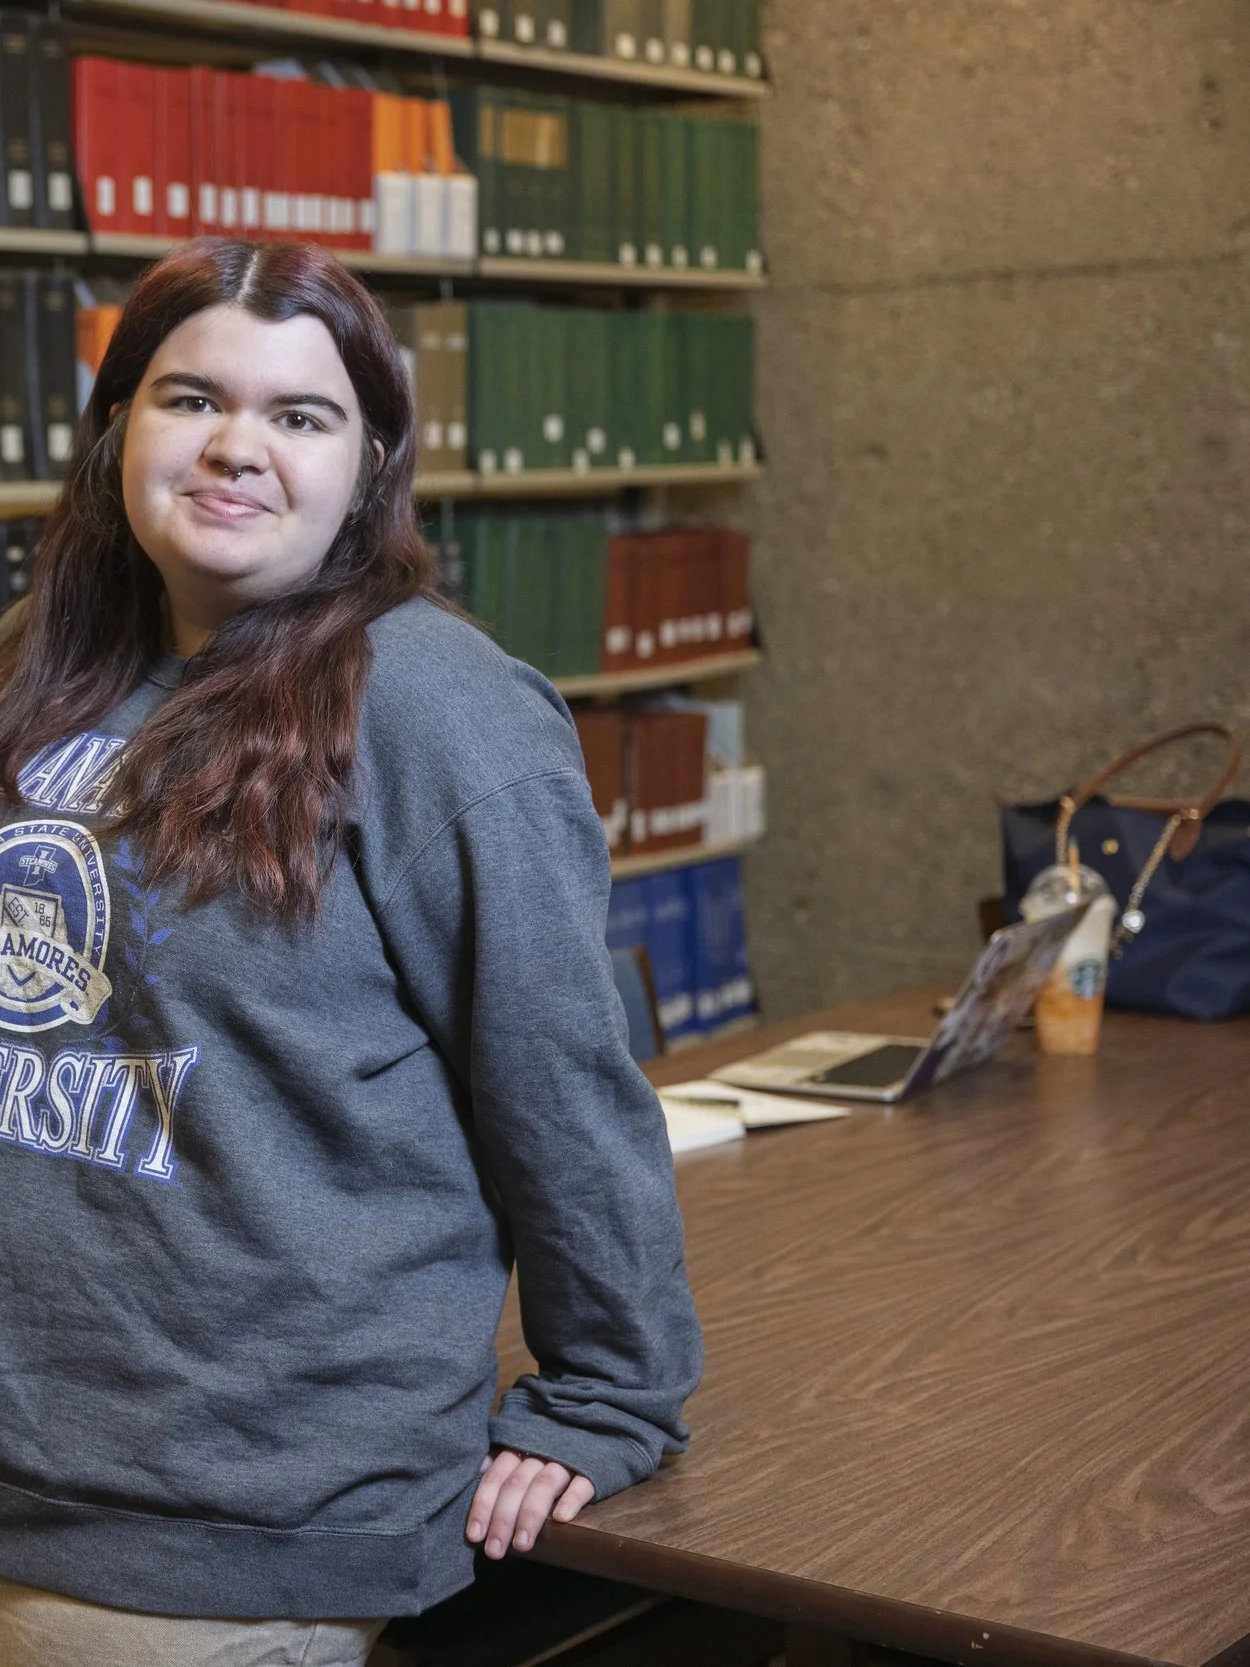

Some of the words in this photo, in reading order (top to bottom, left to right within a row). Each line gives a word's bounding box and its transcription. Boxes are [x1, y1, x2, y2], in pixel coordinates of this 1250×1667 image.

[20, 856, 56, 872] SYCAMORES
[14, 824, 70, 837] STATE
[72, 832, 105, 957] UNIVERSITY
[34, 902, 45, 914] 18
[40, 915, 51, 927] 65
